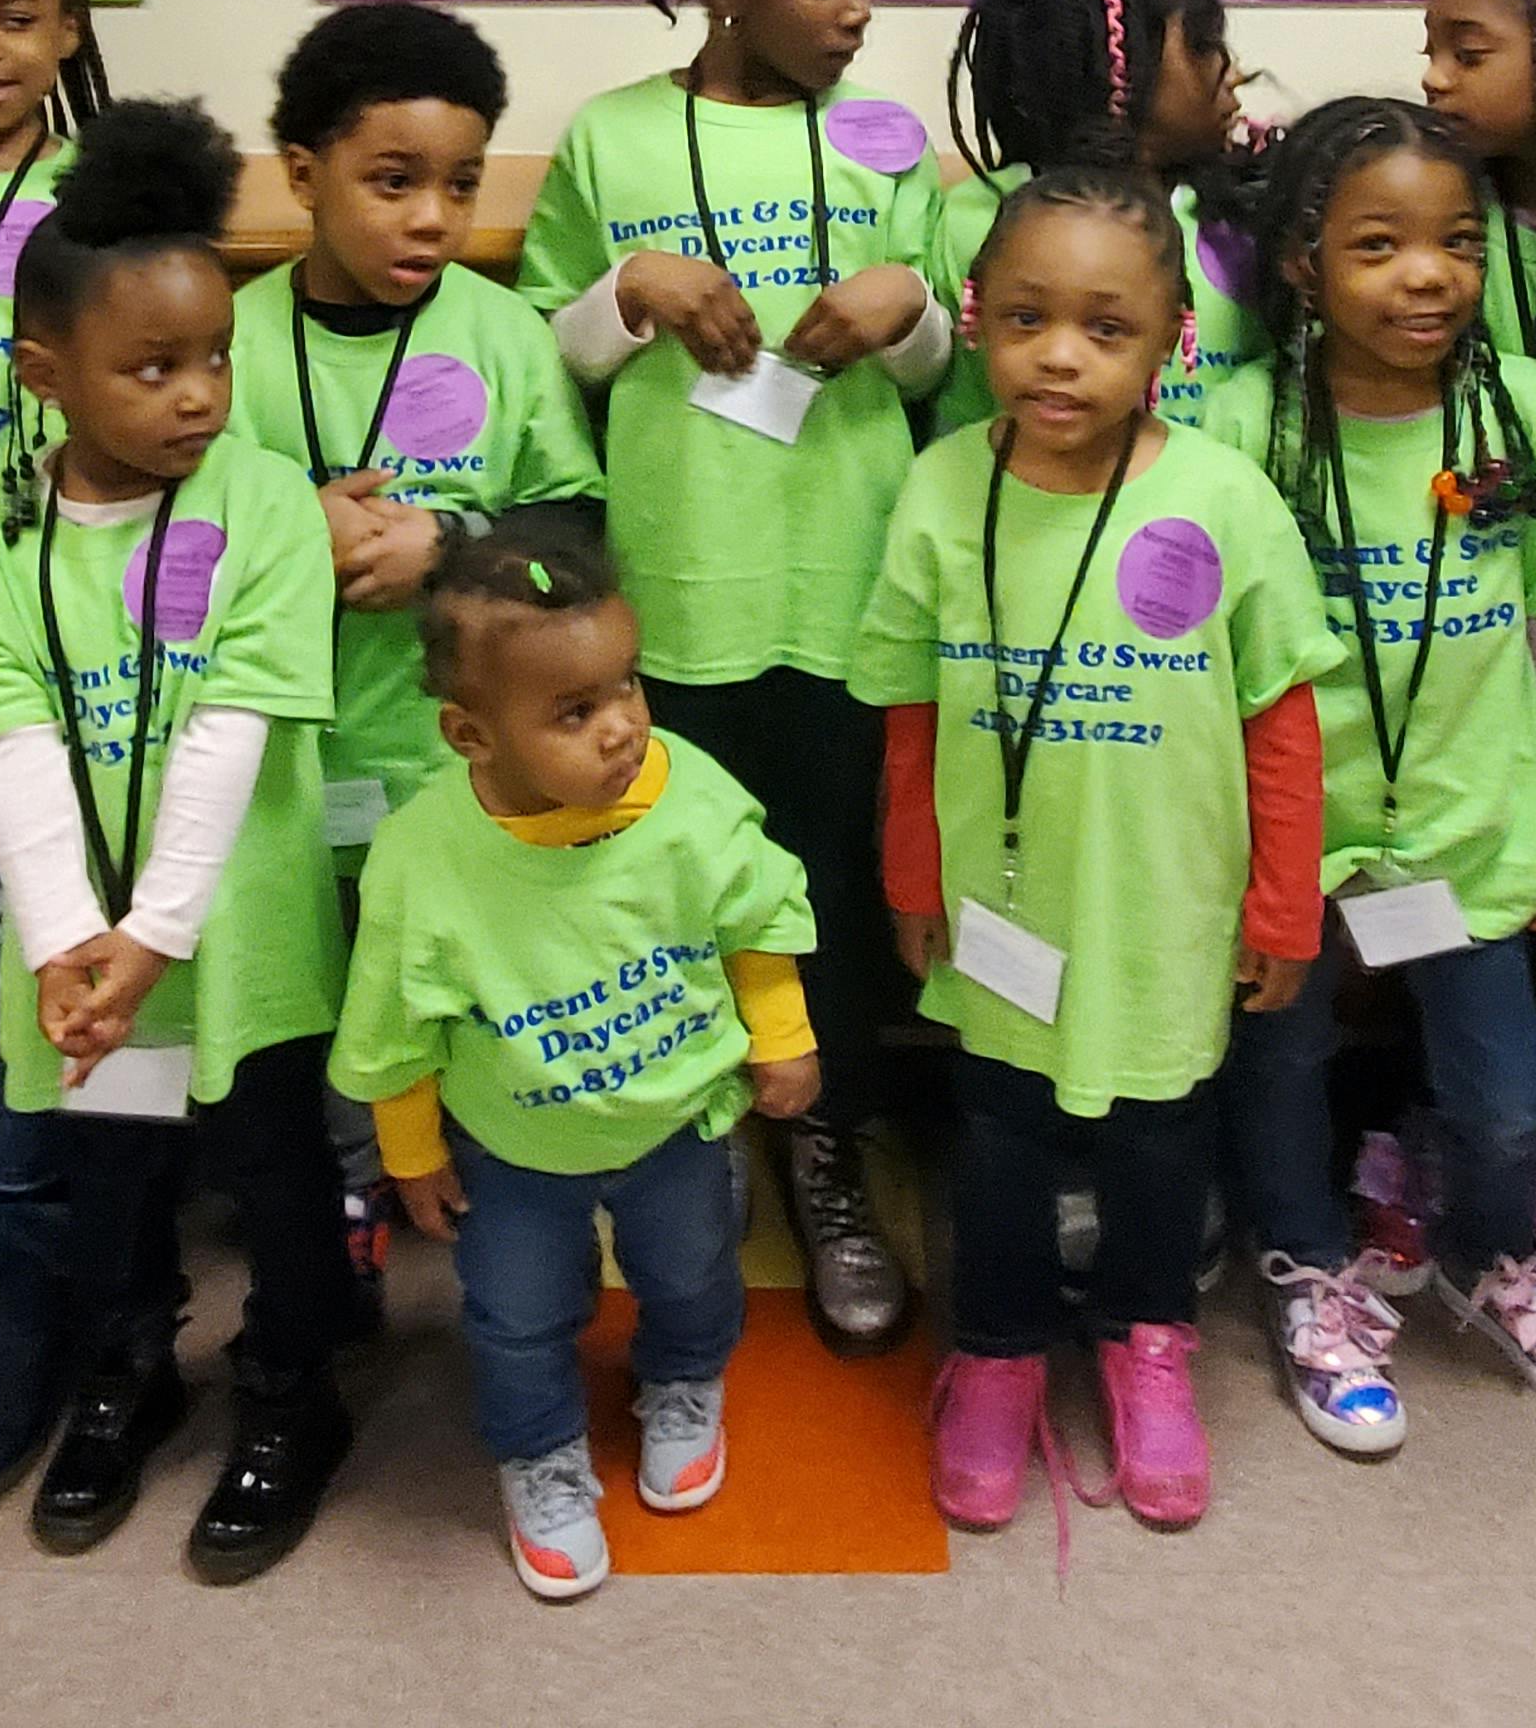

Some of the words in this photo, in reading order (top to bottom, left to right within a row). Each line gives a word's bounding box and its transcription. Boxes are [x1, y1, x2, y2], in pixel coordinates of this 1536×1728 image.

[752, 201, 780, 223] &
[680, 233, 811, 260] Dycare
[1078, 641, 1107, 667] &
[1114, 643, 1212, 672] Sweet
[618, 958, 648, 991] &
[537, 983, 686, 1064] Daycare
